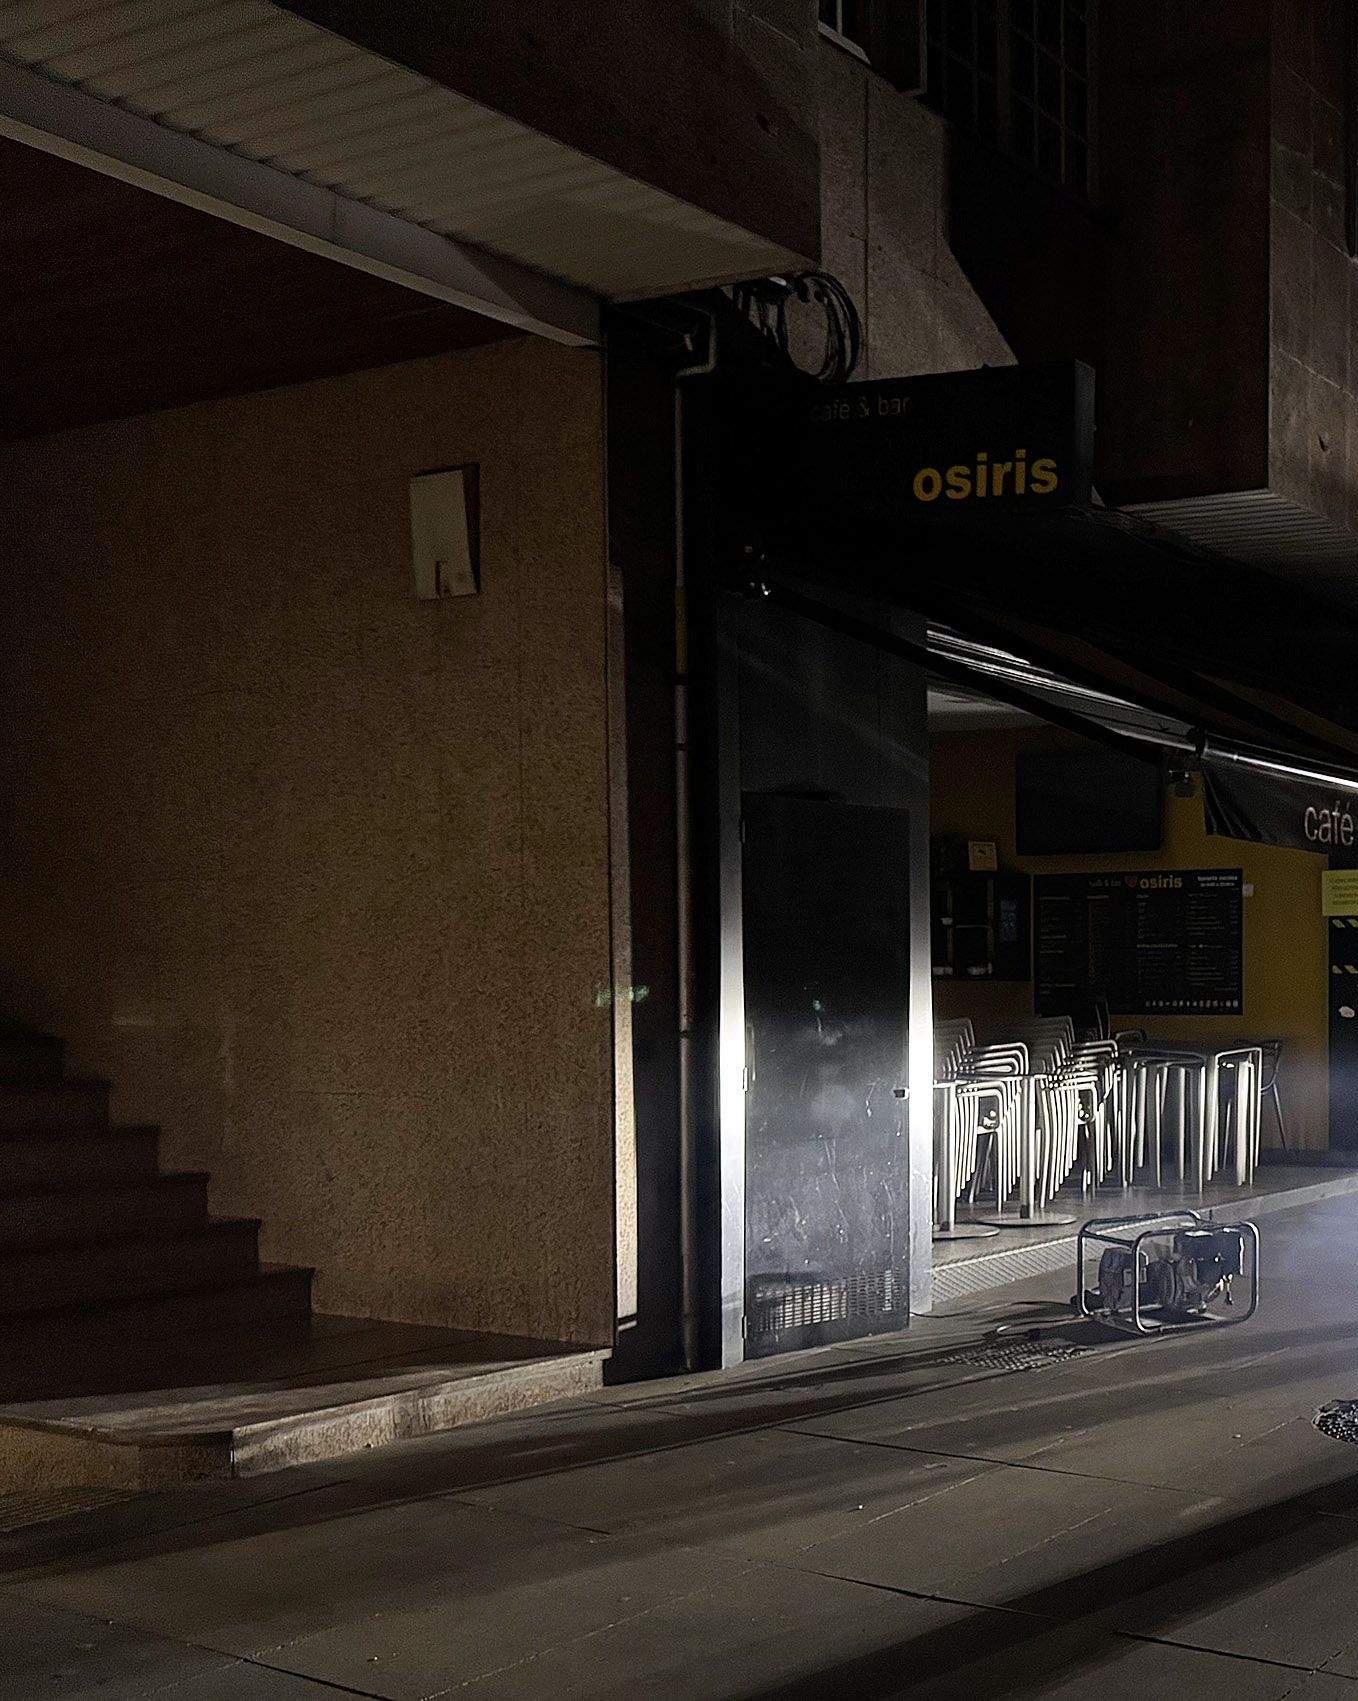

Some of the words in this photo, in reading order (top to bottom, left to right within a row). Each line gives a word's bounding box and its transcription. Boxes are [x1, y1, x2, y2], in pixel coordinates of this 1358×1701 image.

[877, 395, 911, 416] bar
[912, 449, 1059, 502] osiris
[1305, 800, 1354, 846] café
[1140, 874, 1182, 889] osiris
